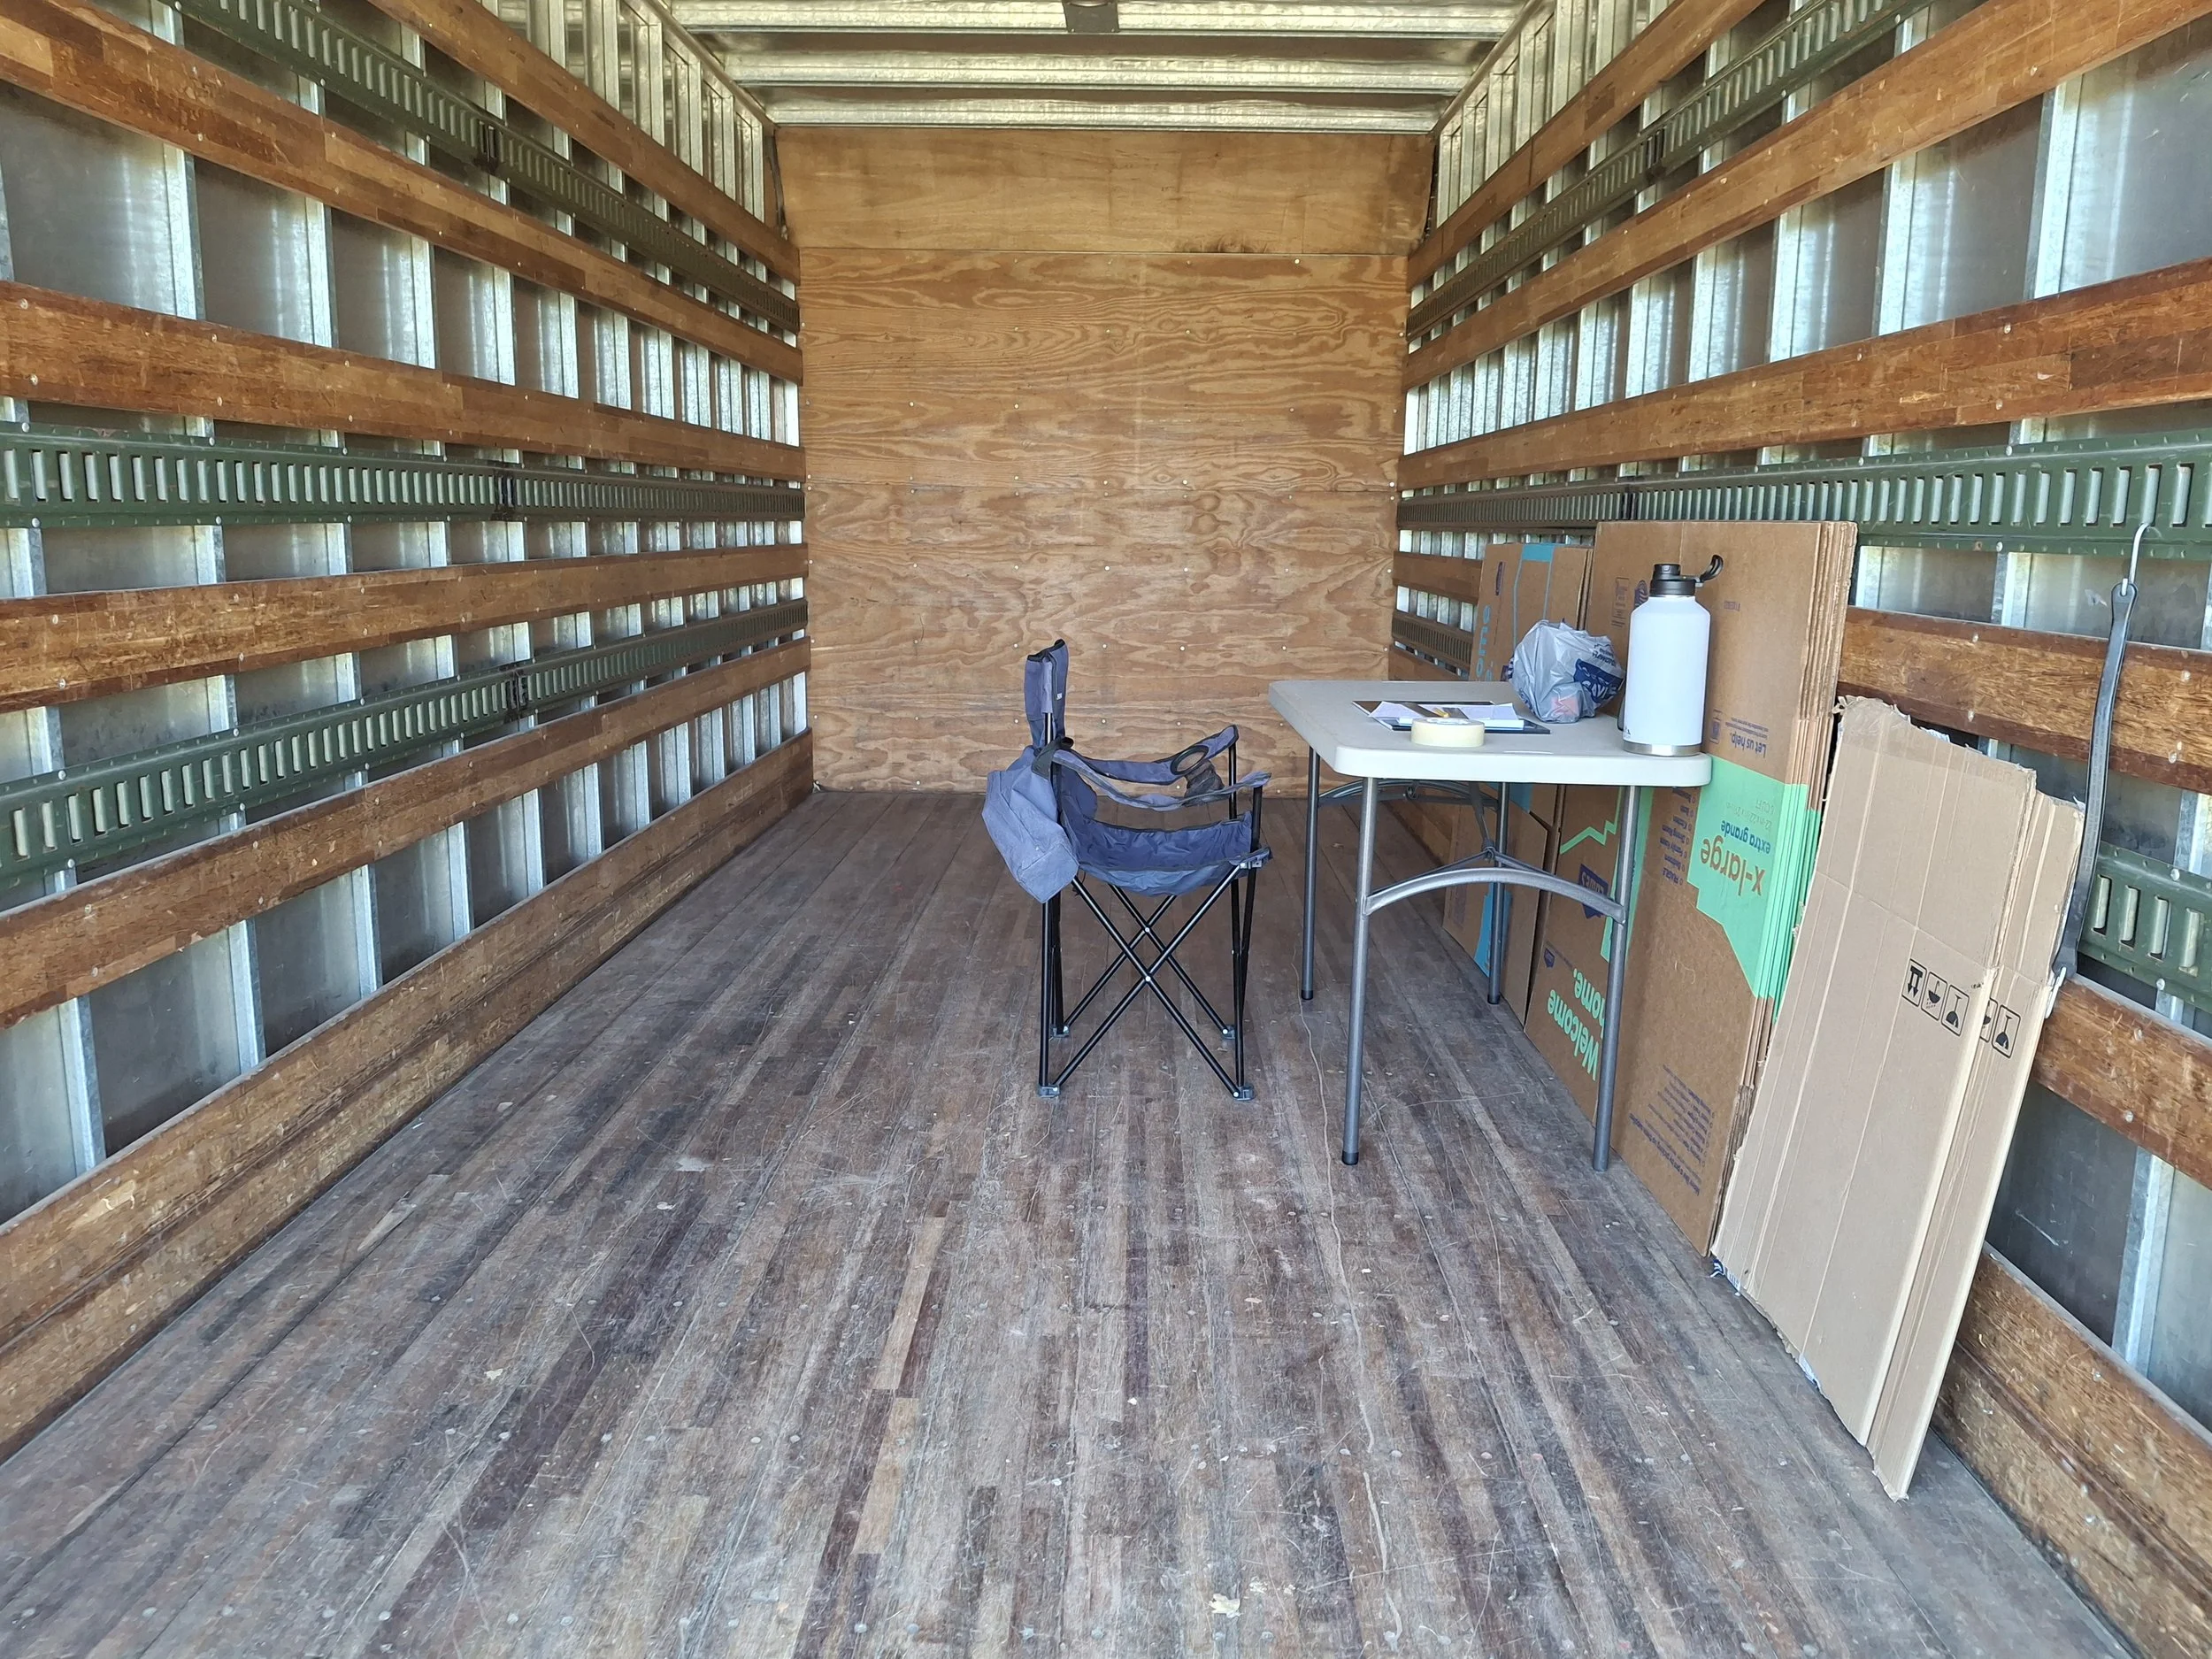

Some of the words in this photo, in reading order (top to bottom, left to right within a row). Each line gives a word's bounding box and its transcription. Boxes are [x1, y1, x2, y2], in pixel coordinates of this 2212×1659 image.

[1730, 732, 1746, 750] help.
[1746, 738, 1755, 750] us
[1755, 741, 1767, 758] Let
[1720, 820, 1748, 842] grande
[1749, 833, 1770, 856] extra
[1700, 834, 1766, 897] x-large
[1547, 989, 1600, 1081] Welcome
